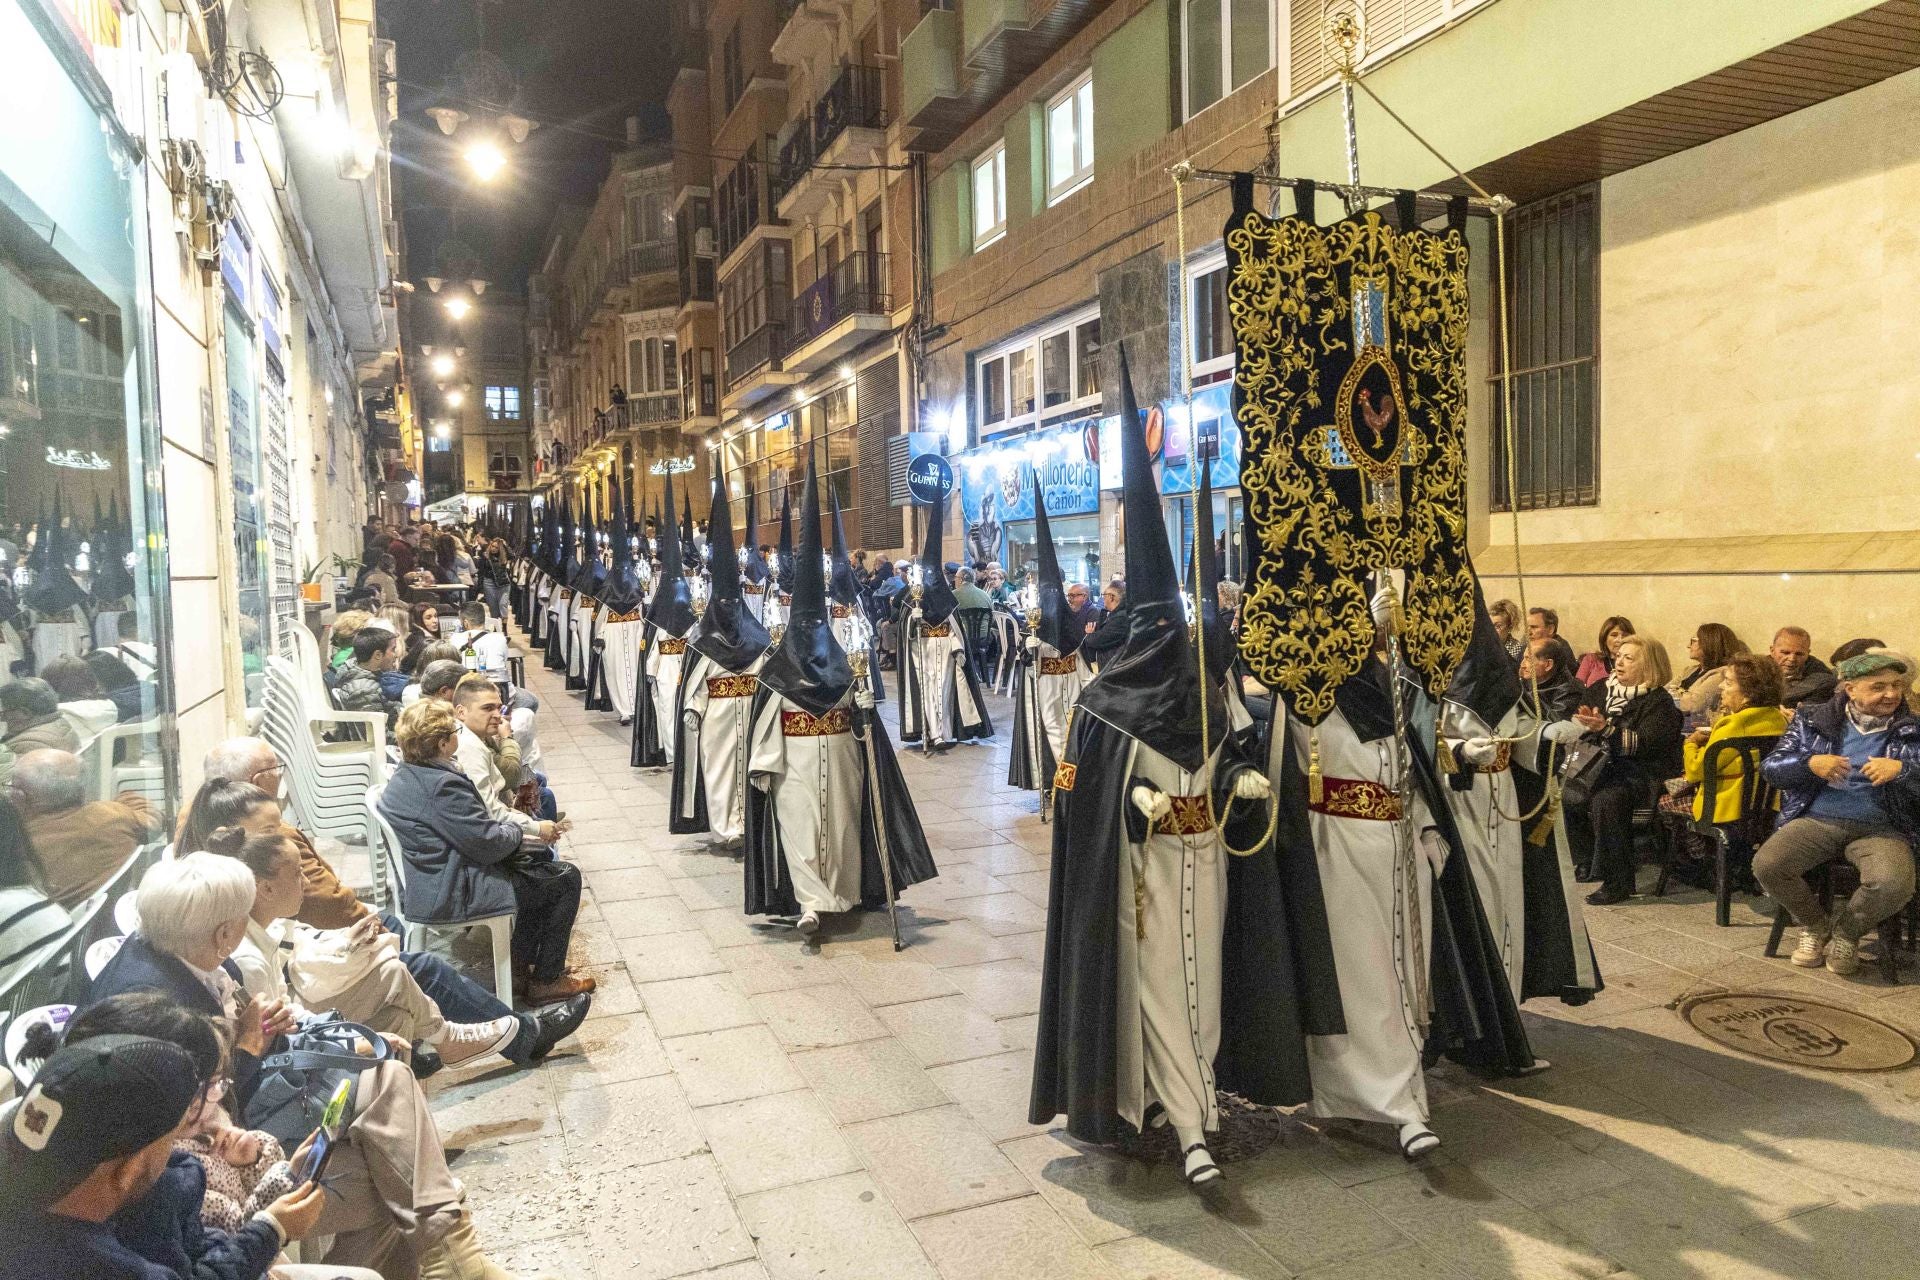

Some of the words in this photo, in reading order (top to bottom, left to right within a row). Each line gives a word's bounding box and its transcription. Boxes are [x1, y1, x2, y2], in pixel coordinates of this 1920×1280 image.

[911, 473, 951, 489] GUINNSS
[1021, 453, 1092, 498] Mejillonería
[1047, 489, 1082, 511] Cañón
